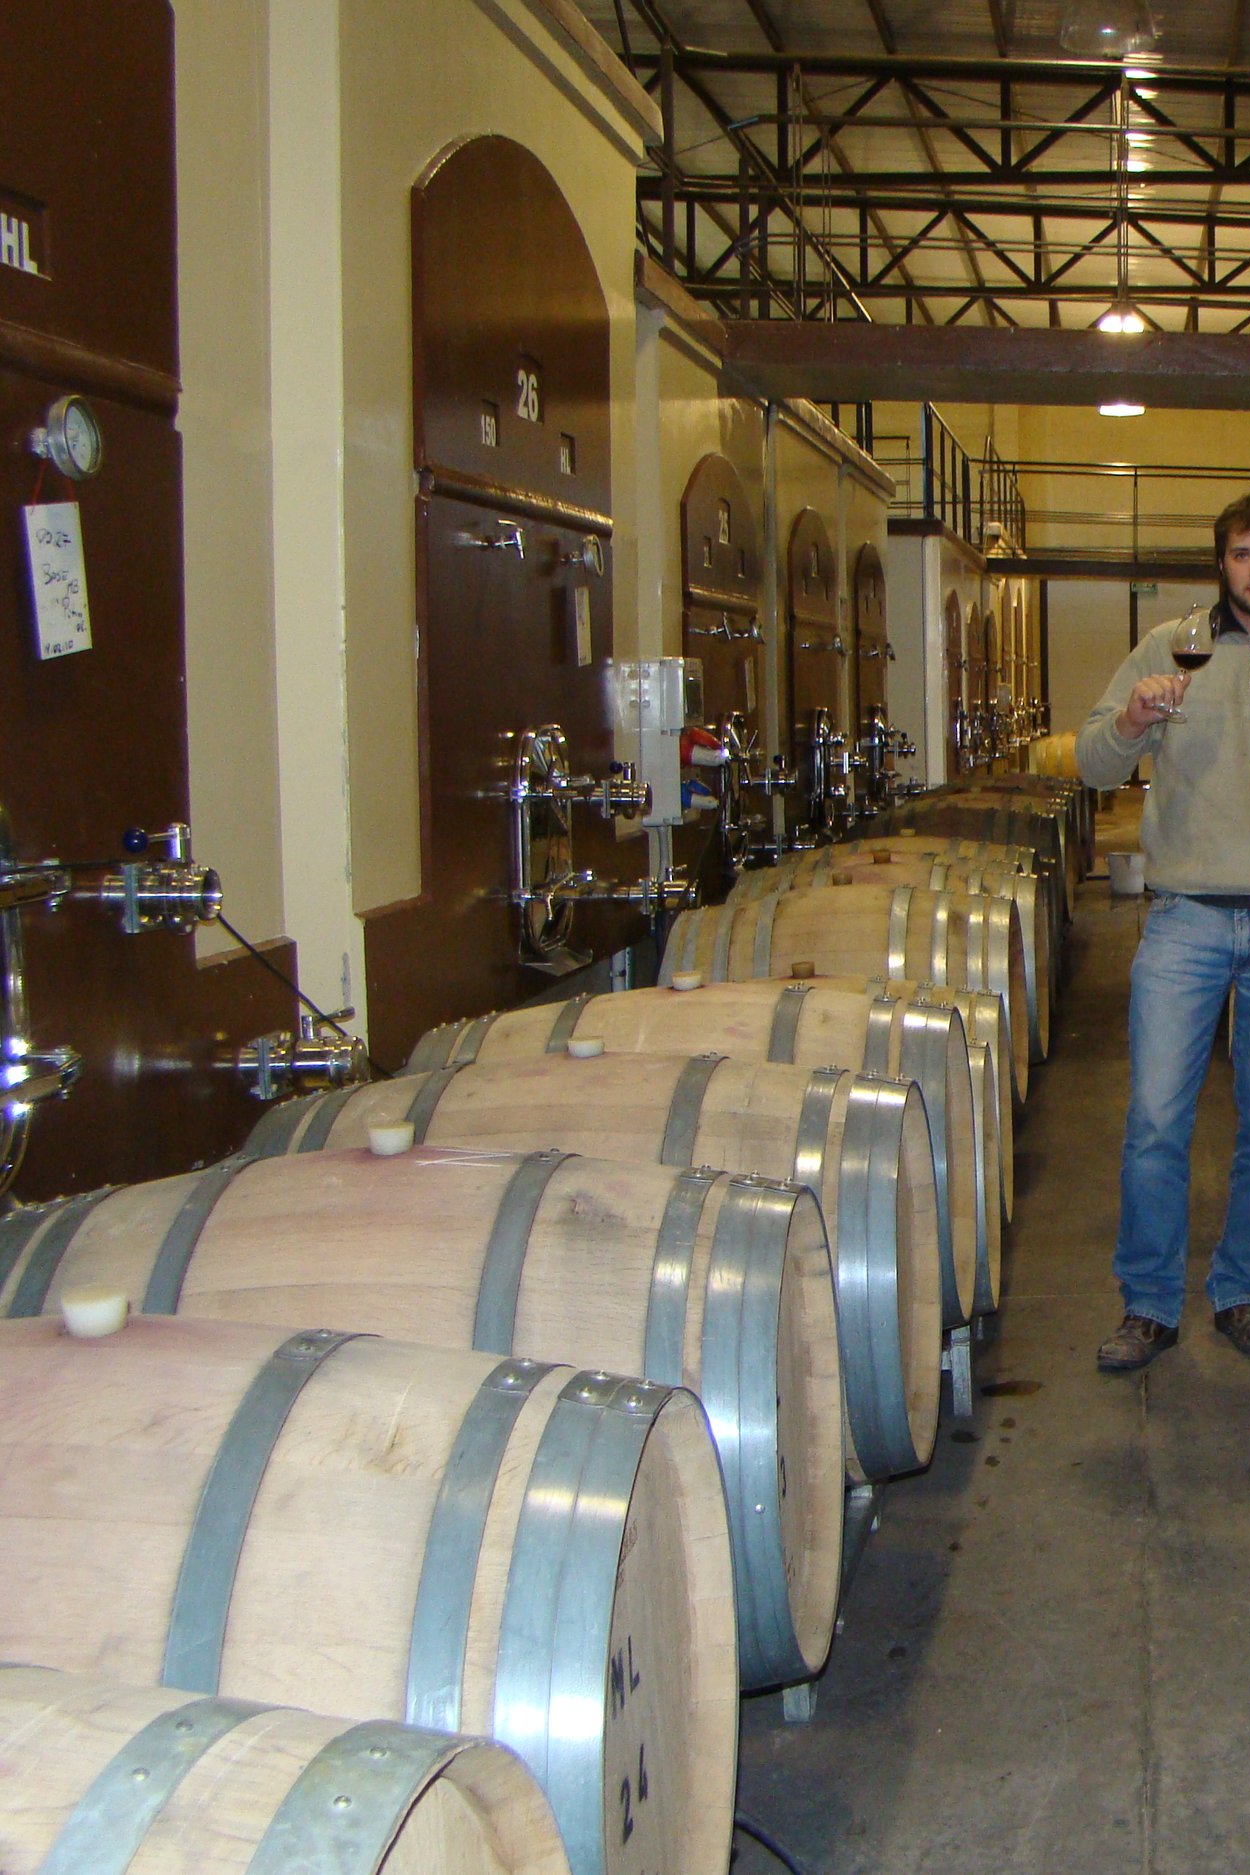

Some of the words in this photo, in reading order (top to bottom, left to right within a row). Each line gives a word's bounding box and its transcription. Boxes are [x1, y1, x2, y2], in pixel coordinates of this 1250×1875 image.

[0, 213, 38, 275] HL
[517, 369, 539, 422] 26
[481, 413, 496, 447] 150
